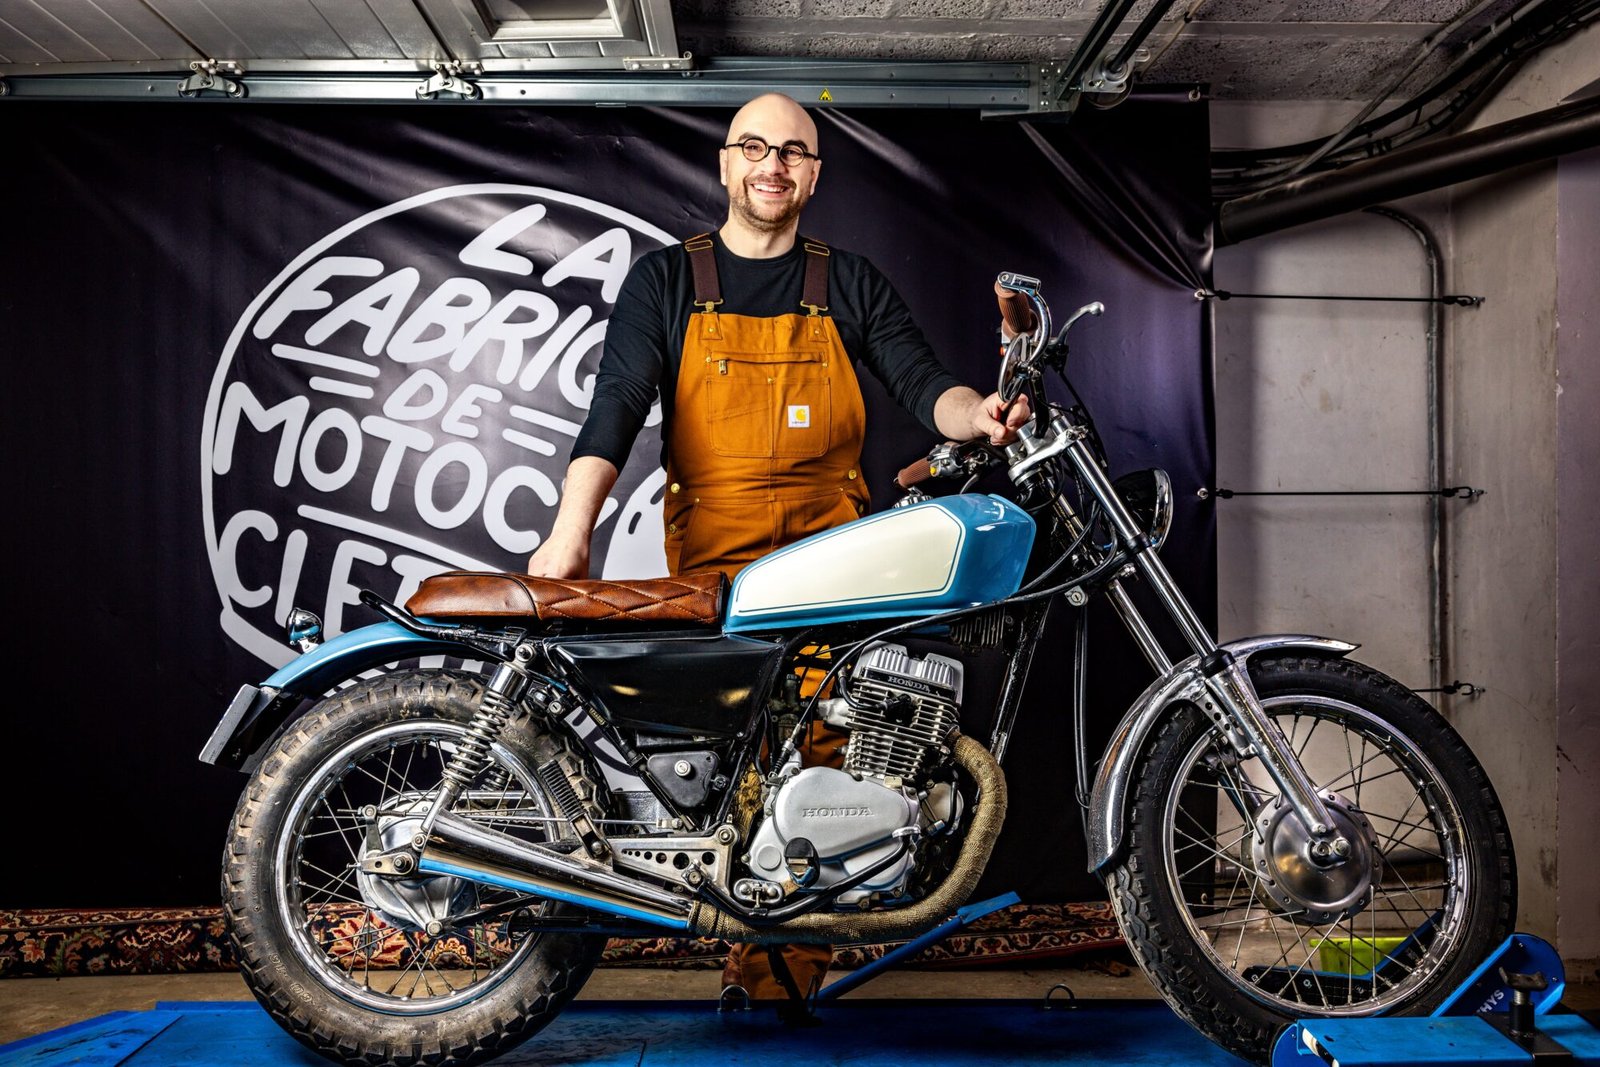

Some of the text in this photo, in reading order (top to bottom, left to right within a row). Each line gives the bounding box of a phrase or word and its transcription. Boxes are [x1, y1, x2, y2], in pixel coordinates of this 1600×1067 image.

[459, 203, 631, 303] LA
[253, 256, 609, 410] FABRIQ
[382, 369, 502, 438] DE
[213, 381, 618, 554] MOTOC
[887, 675, 931, 693] HONDA
[802, 806, 875, 818] HONDA
[1476, 989, 1505, 1013] HYS
